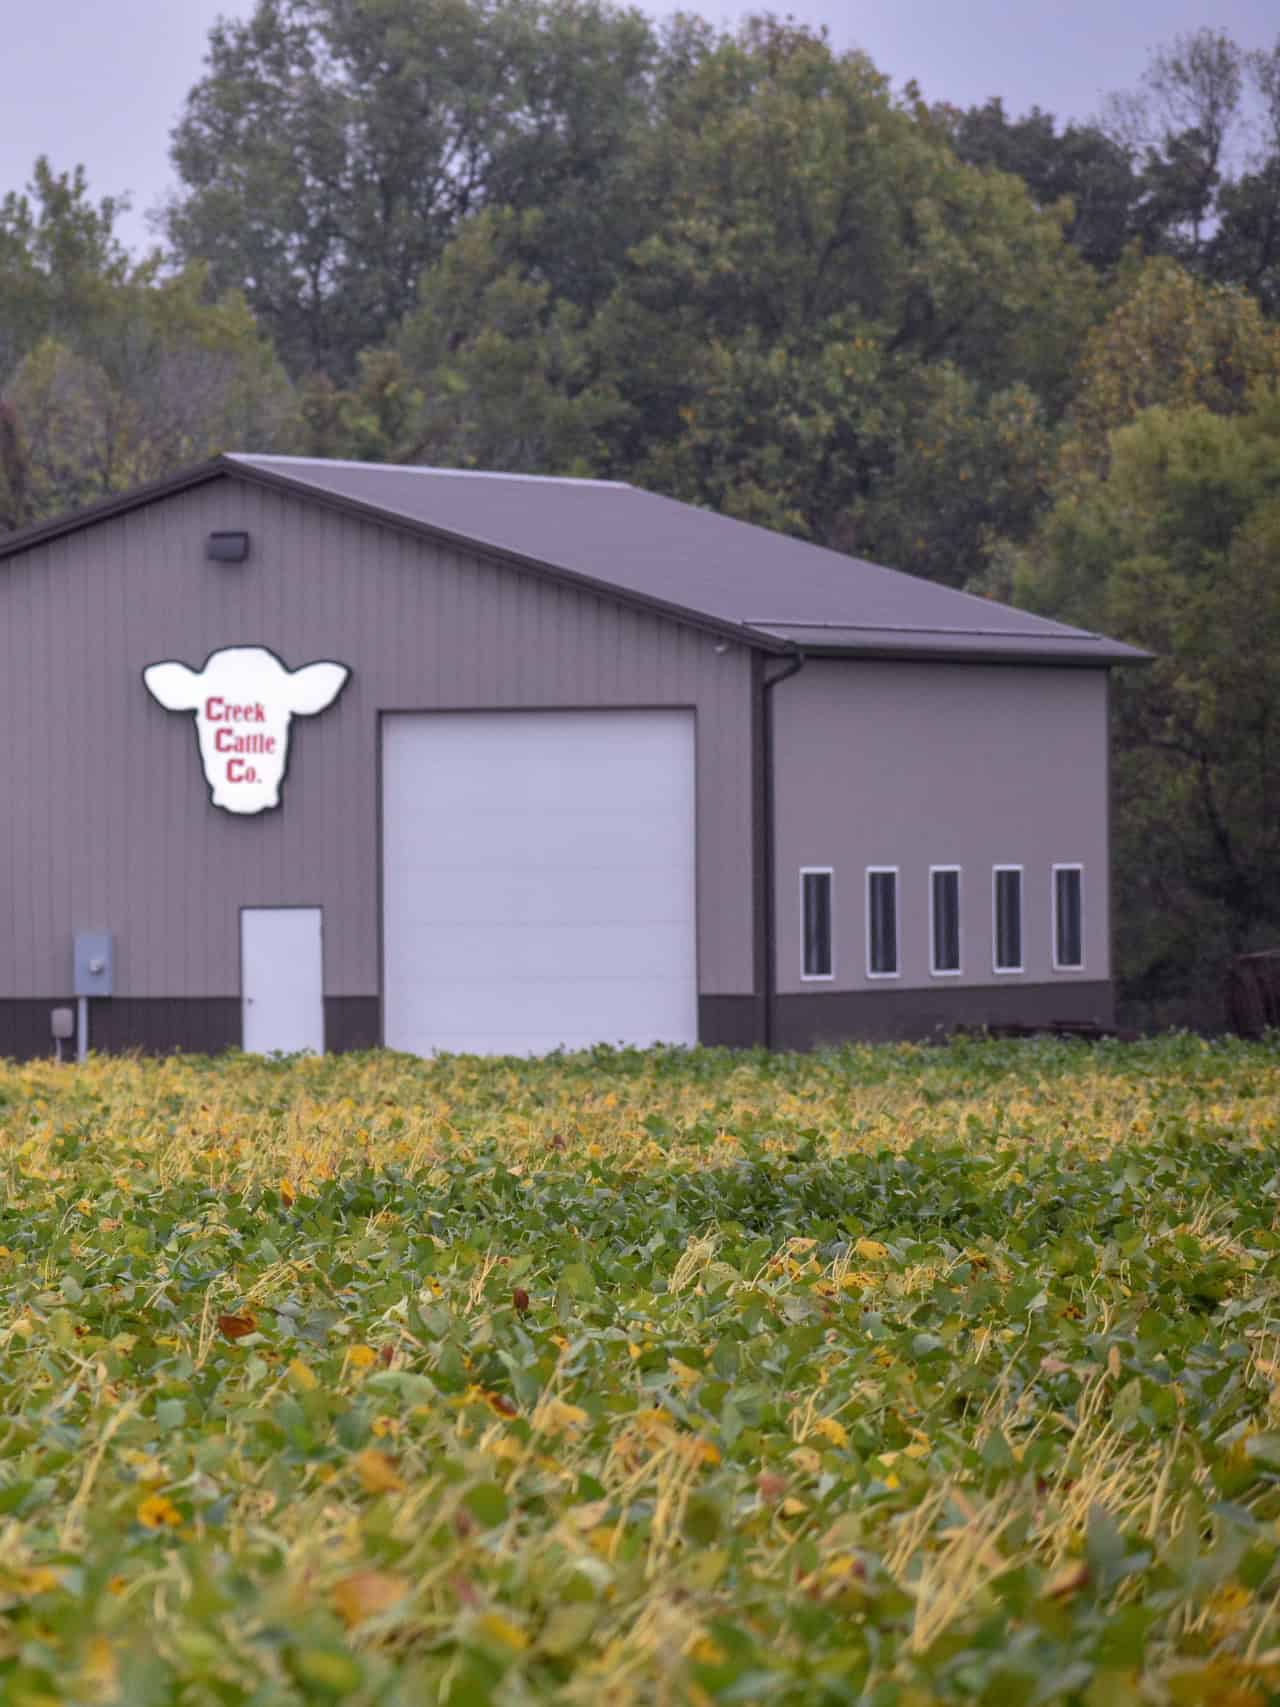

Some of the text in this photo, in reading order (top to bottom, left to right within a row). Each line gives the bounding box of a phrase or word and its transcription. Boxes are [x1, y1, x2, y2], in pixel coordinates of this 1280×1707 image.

[205, 697, 267, 722] Creek
[215, 727, 276, 754] Cattle
[226, 758, 262, 784] Co.
